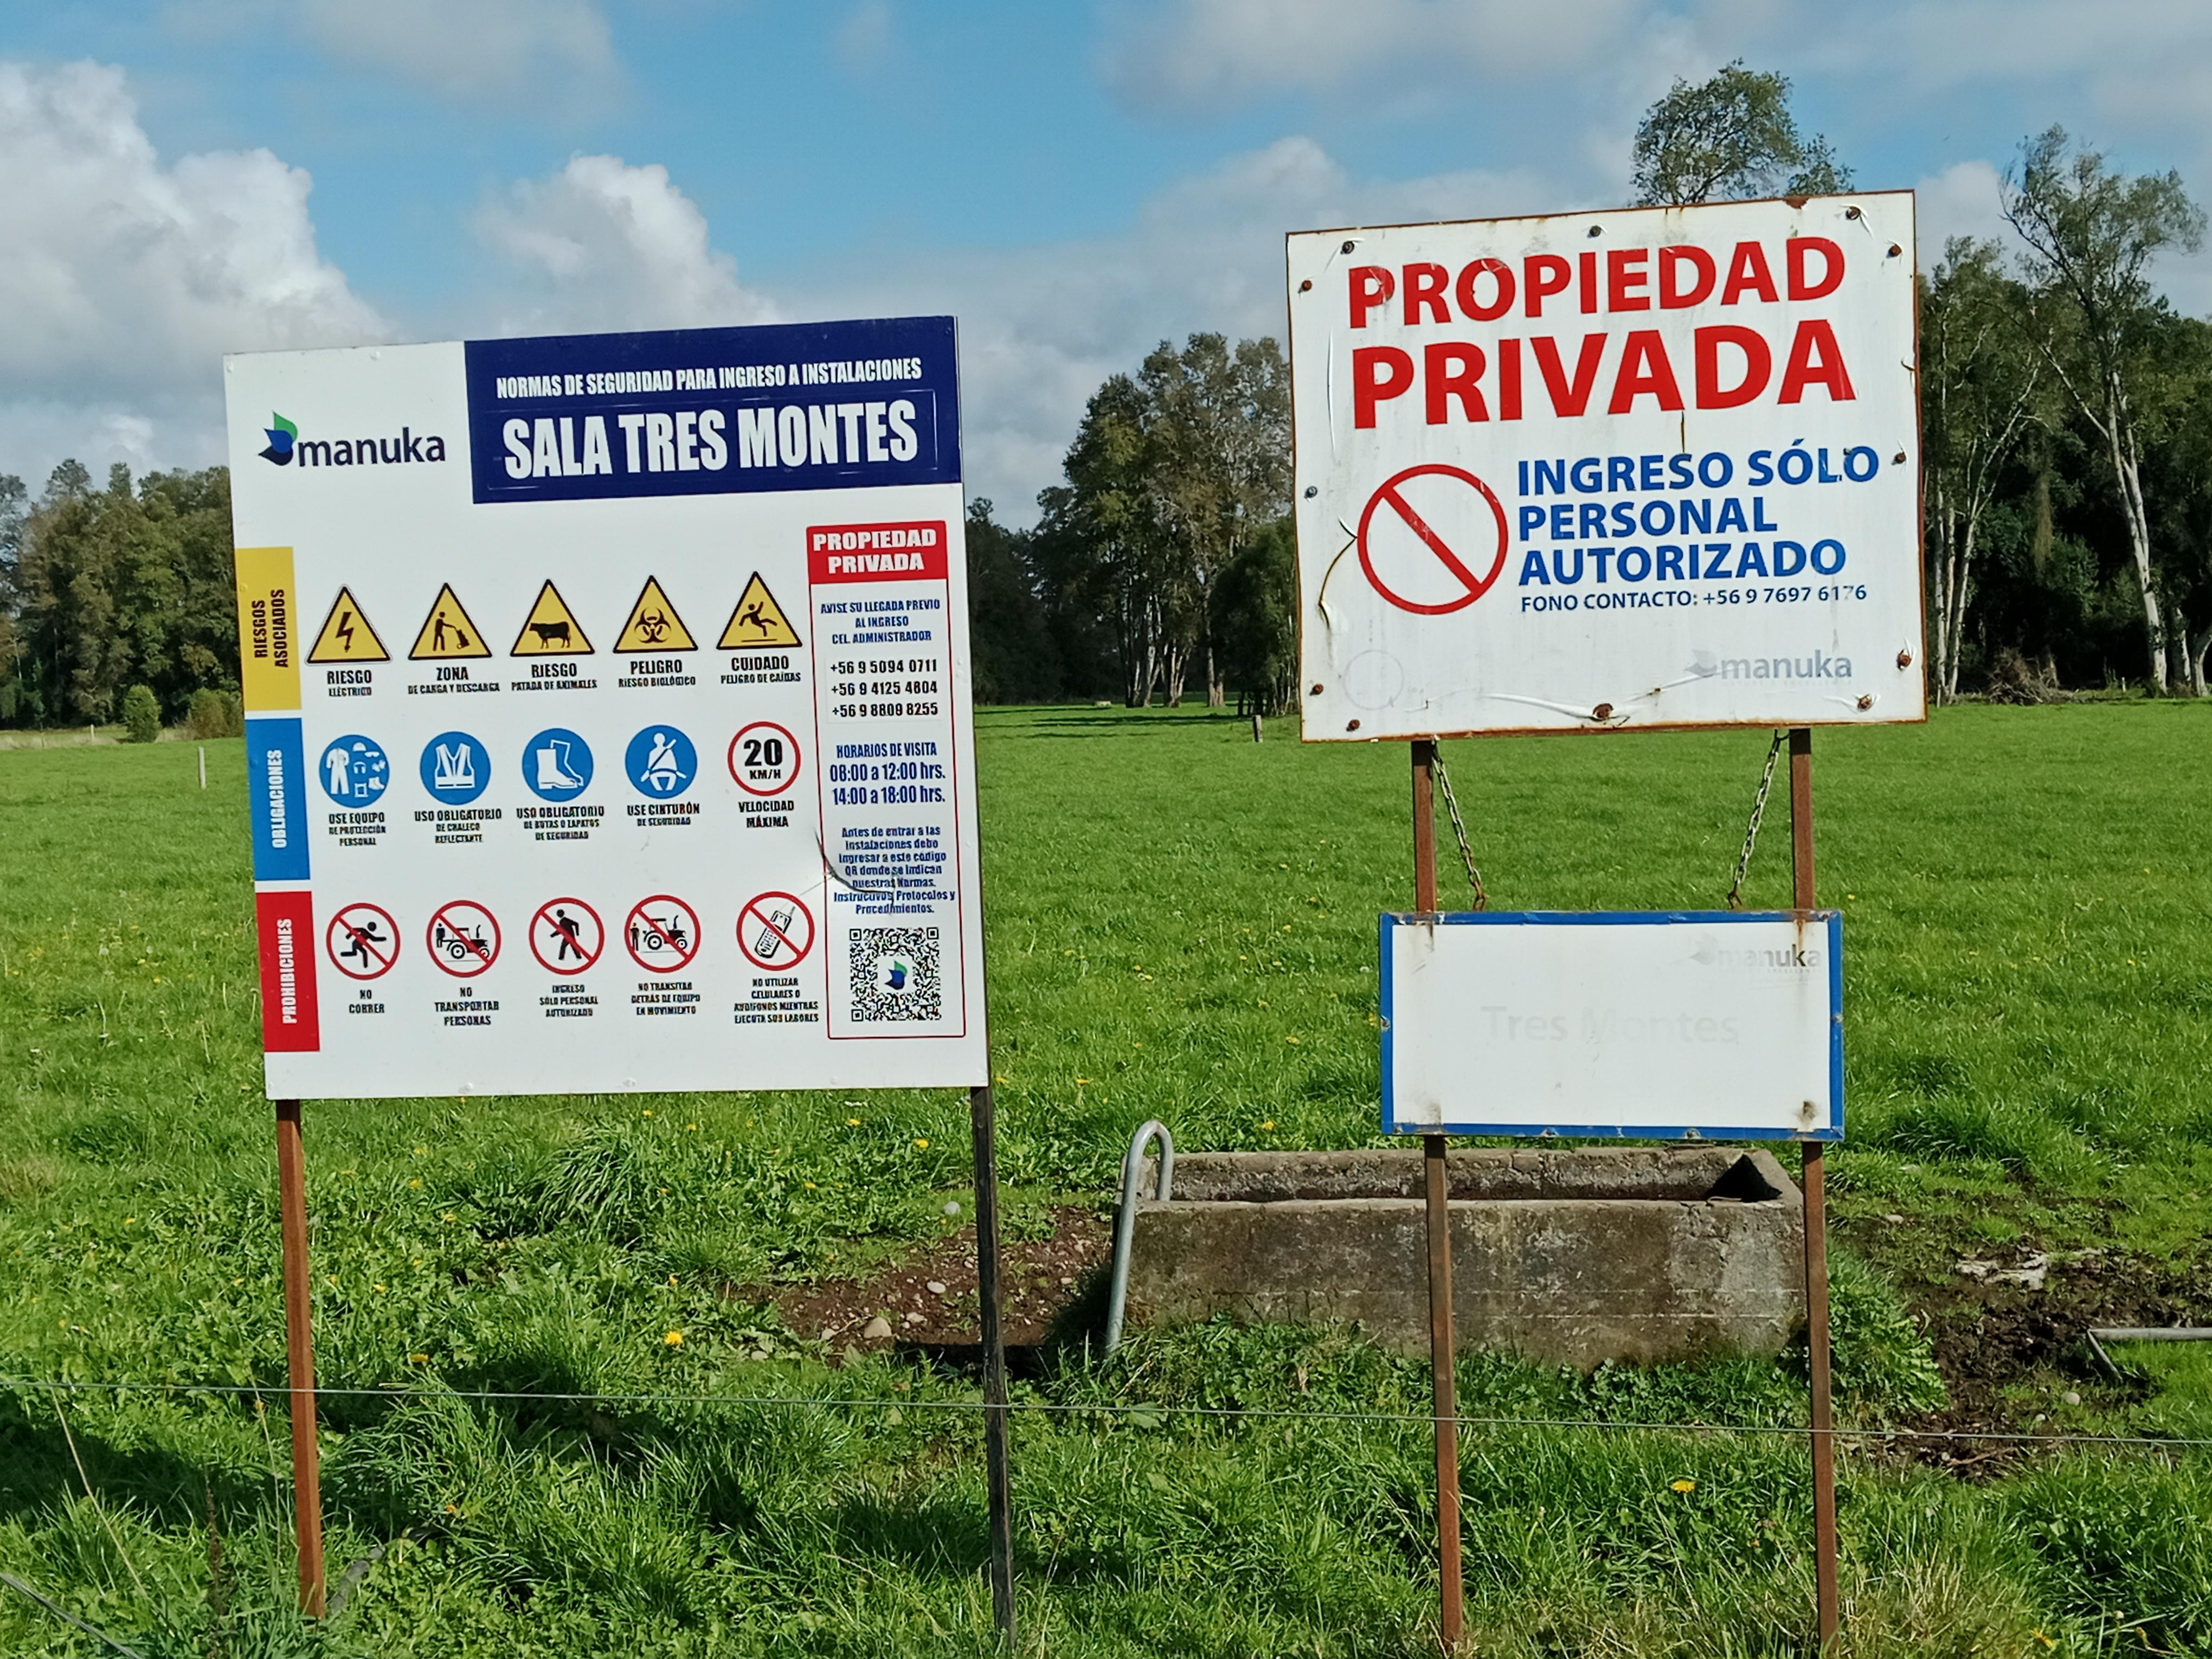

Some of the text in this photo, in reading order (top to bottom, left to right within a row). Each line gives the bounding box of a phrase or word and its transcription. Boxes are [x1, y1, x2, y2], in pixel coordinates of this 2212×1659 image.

[1348, 236, 1846, 329] PROPIEDAD
[496, 357, 922, 399] NORMAS DE SEGURIDAD PARA INGRESO A INSTALACIONES
[1353, 318, 1857, 429] PRIVADA
[298, 427, 446, 467] manuka
[502, 400, 918, 480] SALA TRES MONTES
[1518, 439, 1880, 496] INGRESO SÓLO
[1518, 496, 1777, 542] PERSONAL
[813, 529, 936, 551] PROPIEDAD
[828, 552, 924, 574] PRIVADA
[1518, 538, 1846, 587] AUTORIZADO
[1521, 584, 1867, 612] FONO CONTACTO: +56 9 7697 6176
[251, 599, 268, 658] RIESGOS
[271, 589, 288, 668] ASOCIADOS
[832, 630, 931, 644] CEL. ADMINISTRADOR
[436, 667, 468, 681] ZONA
[531, 663, 577, 678] RIESGO
[630, 659, 683, 674] PELIGRO
[731, 655, 789, 671] CUIDADO
[830, 659, 937, 674] +56 9 5094 0711
[1720, 651, 1853, 679] manuka
[327, 670, 372, 684] RIESGO
[831, 683, 855, 696] +56
[871, 681, 901, 695] 4125
[832, 702, 938, 717] +56 9 8809 8255
[743, 738, 783, 767] 20
[837, 742, 937, 758] HORARIOS DE VISITA
[829, 761, 946, 782] 08:00 a 12:00 hrs.
[267, 749, 287, 849] OBLIGACIONES
[832, 785, 946, 805] 14:00 a 18:00 hrs.
[437, 808, 502, 821] OBLIGATORIO
[648, 801, 700, 815] CINTURÓN
[738, 800, 795, 813] VELOCIDAD
[350, 812, 385, 824] EQUIPO
[747, 814, 789, 828] MÁXIMA
[1717, 944, 1821, 969] manuka
[277, 918, 297, 1025] PROHIBICIONES
[1481, 1006, 1738, 1043] Tres Montes
